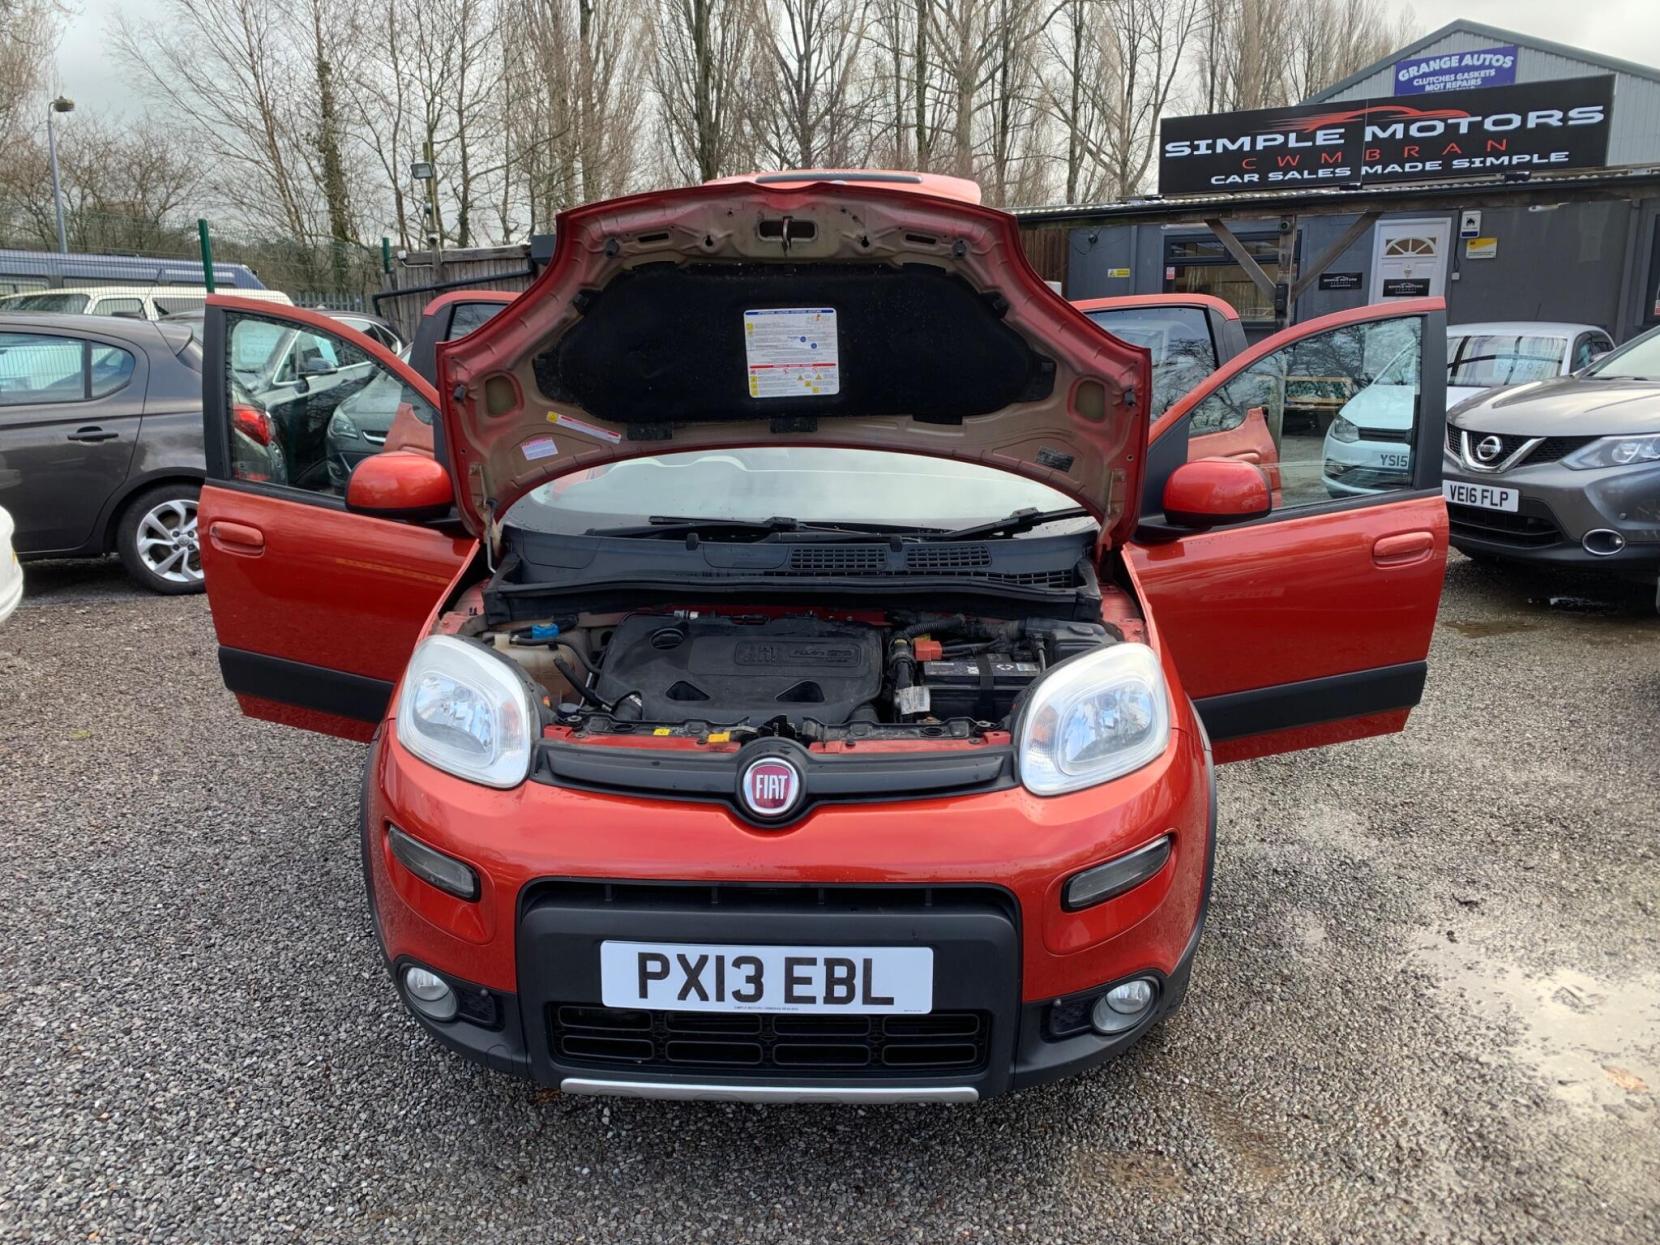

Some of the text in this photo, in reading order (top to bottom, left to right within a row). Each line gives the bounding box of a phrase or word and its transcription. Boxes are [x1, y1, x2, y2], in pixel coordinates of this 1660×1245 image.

[1398, 54, 1514, 81] GRANGE AUTOS
[1413, 69, 1496, 86] CLUTCHES GASKETS
[1425, 83, 1444, 92] MOT
[1446, 78, 1482, 90] REPAIRS
[1165, 105, 1604, 157] SIMPLE MOTORS
[1242, 139, 1507, 169] CWMBRAN
[1211, 151, 1570, 185] CAR SALES MADE SIMPLE
[1380, 454, 1409, 467] YS15
[1450, 485, 1509, 507] VE16 FLP
[756, 774, 788, 800] FIAT
[637, 952, 895, 1006] PX13 EBL
